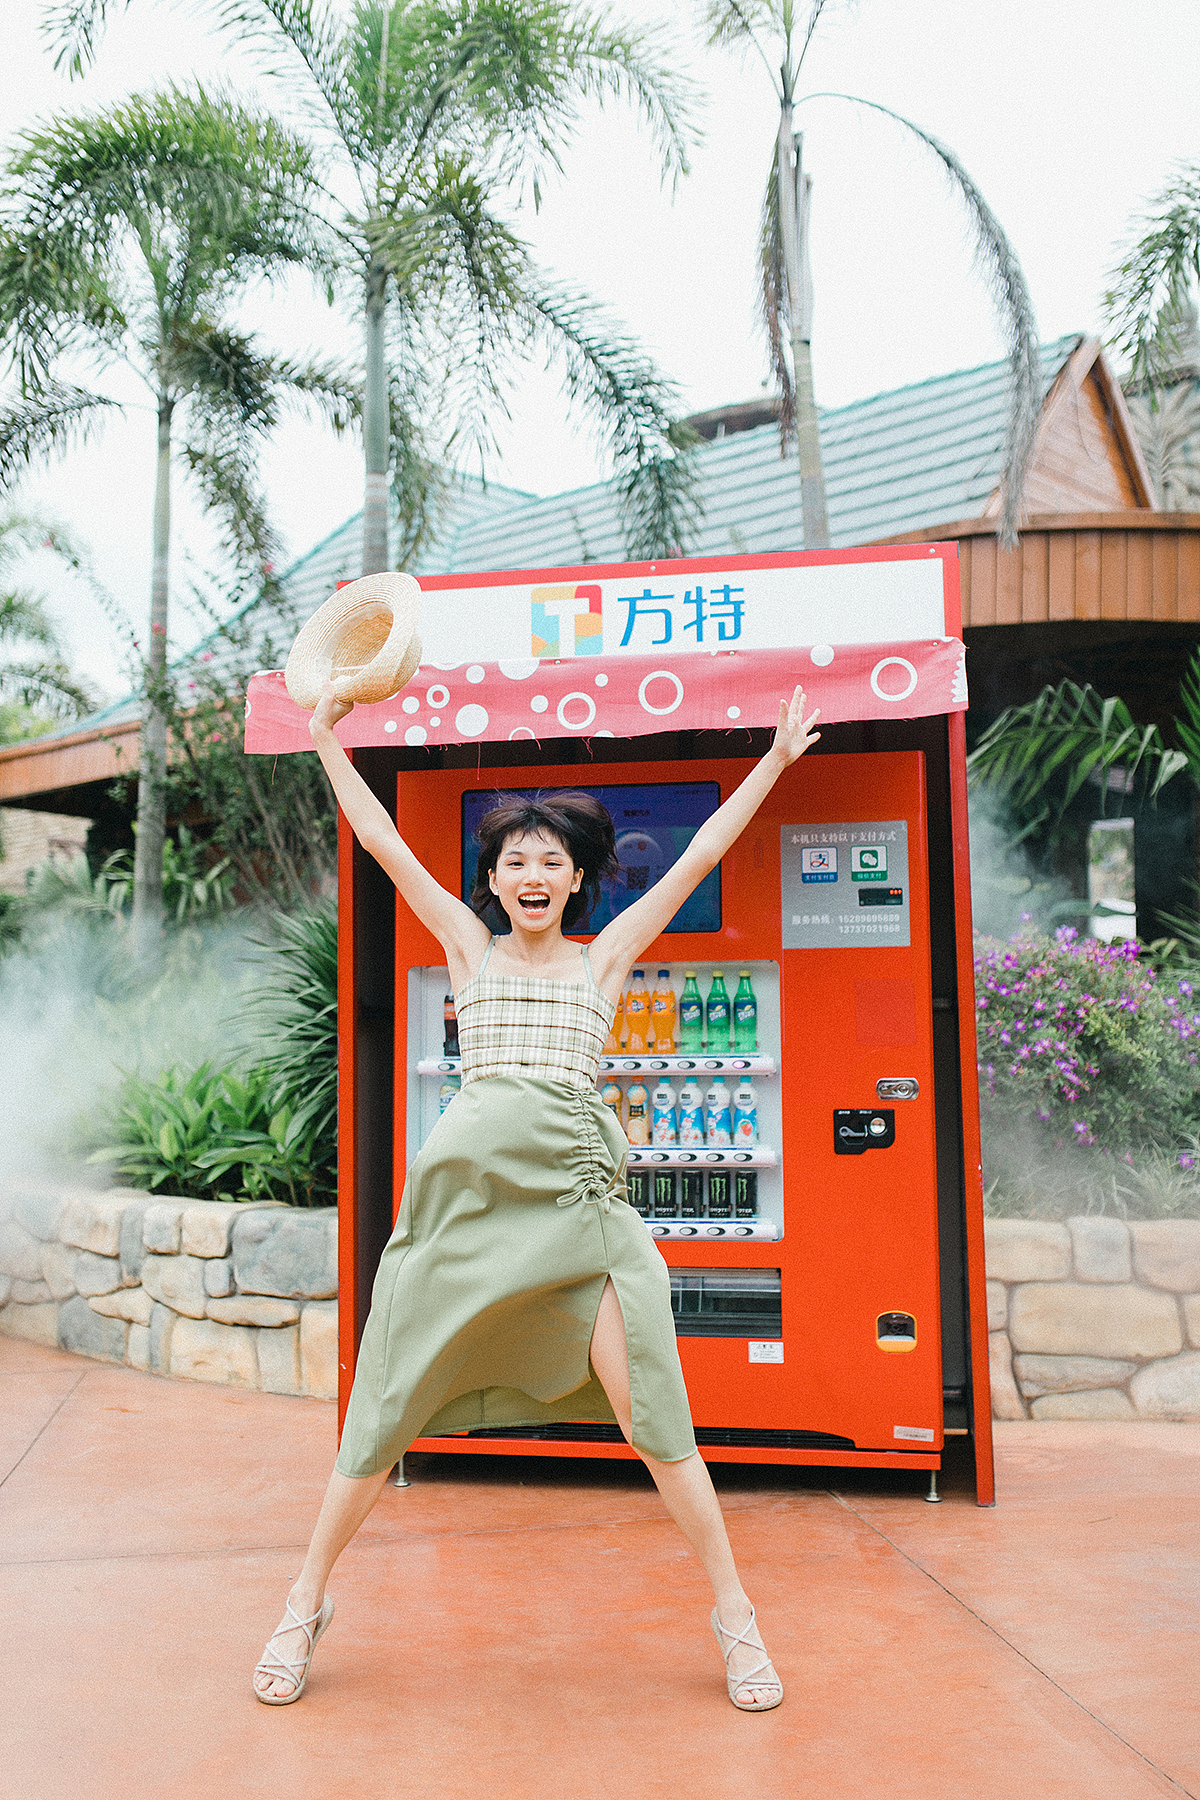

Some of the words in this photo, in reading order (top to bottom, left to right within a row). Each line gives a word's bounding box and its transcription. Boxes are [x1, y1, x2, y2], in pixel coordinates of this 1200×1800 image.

[617, 584, 746, 648] 方特
[791, 832, 896, 844] 本机只支持以下支付方式
